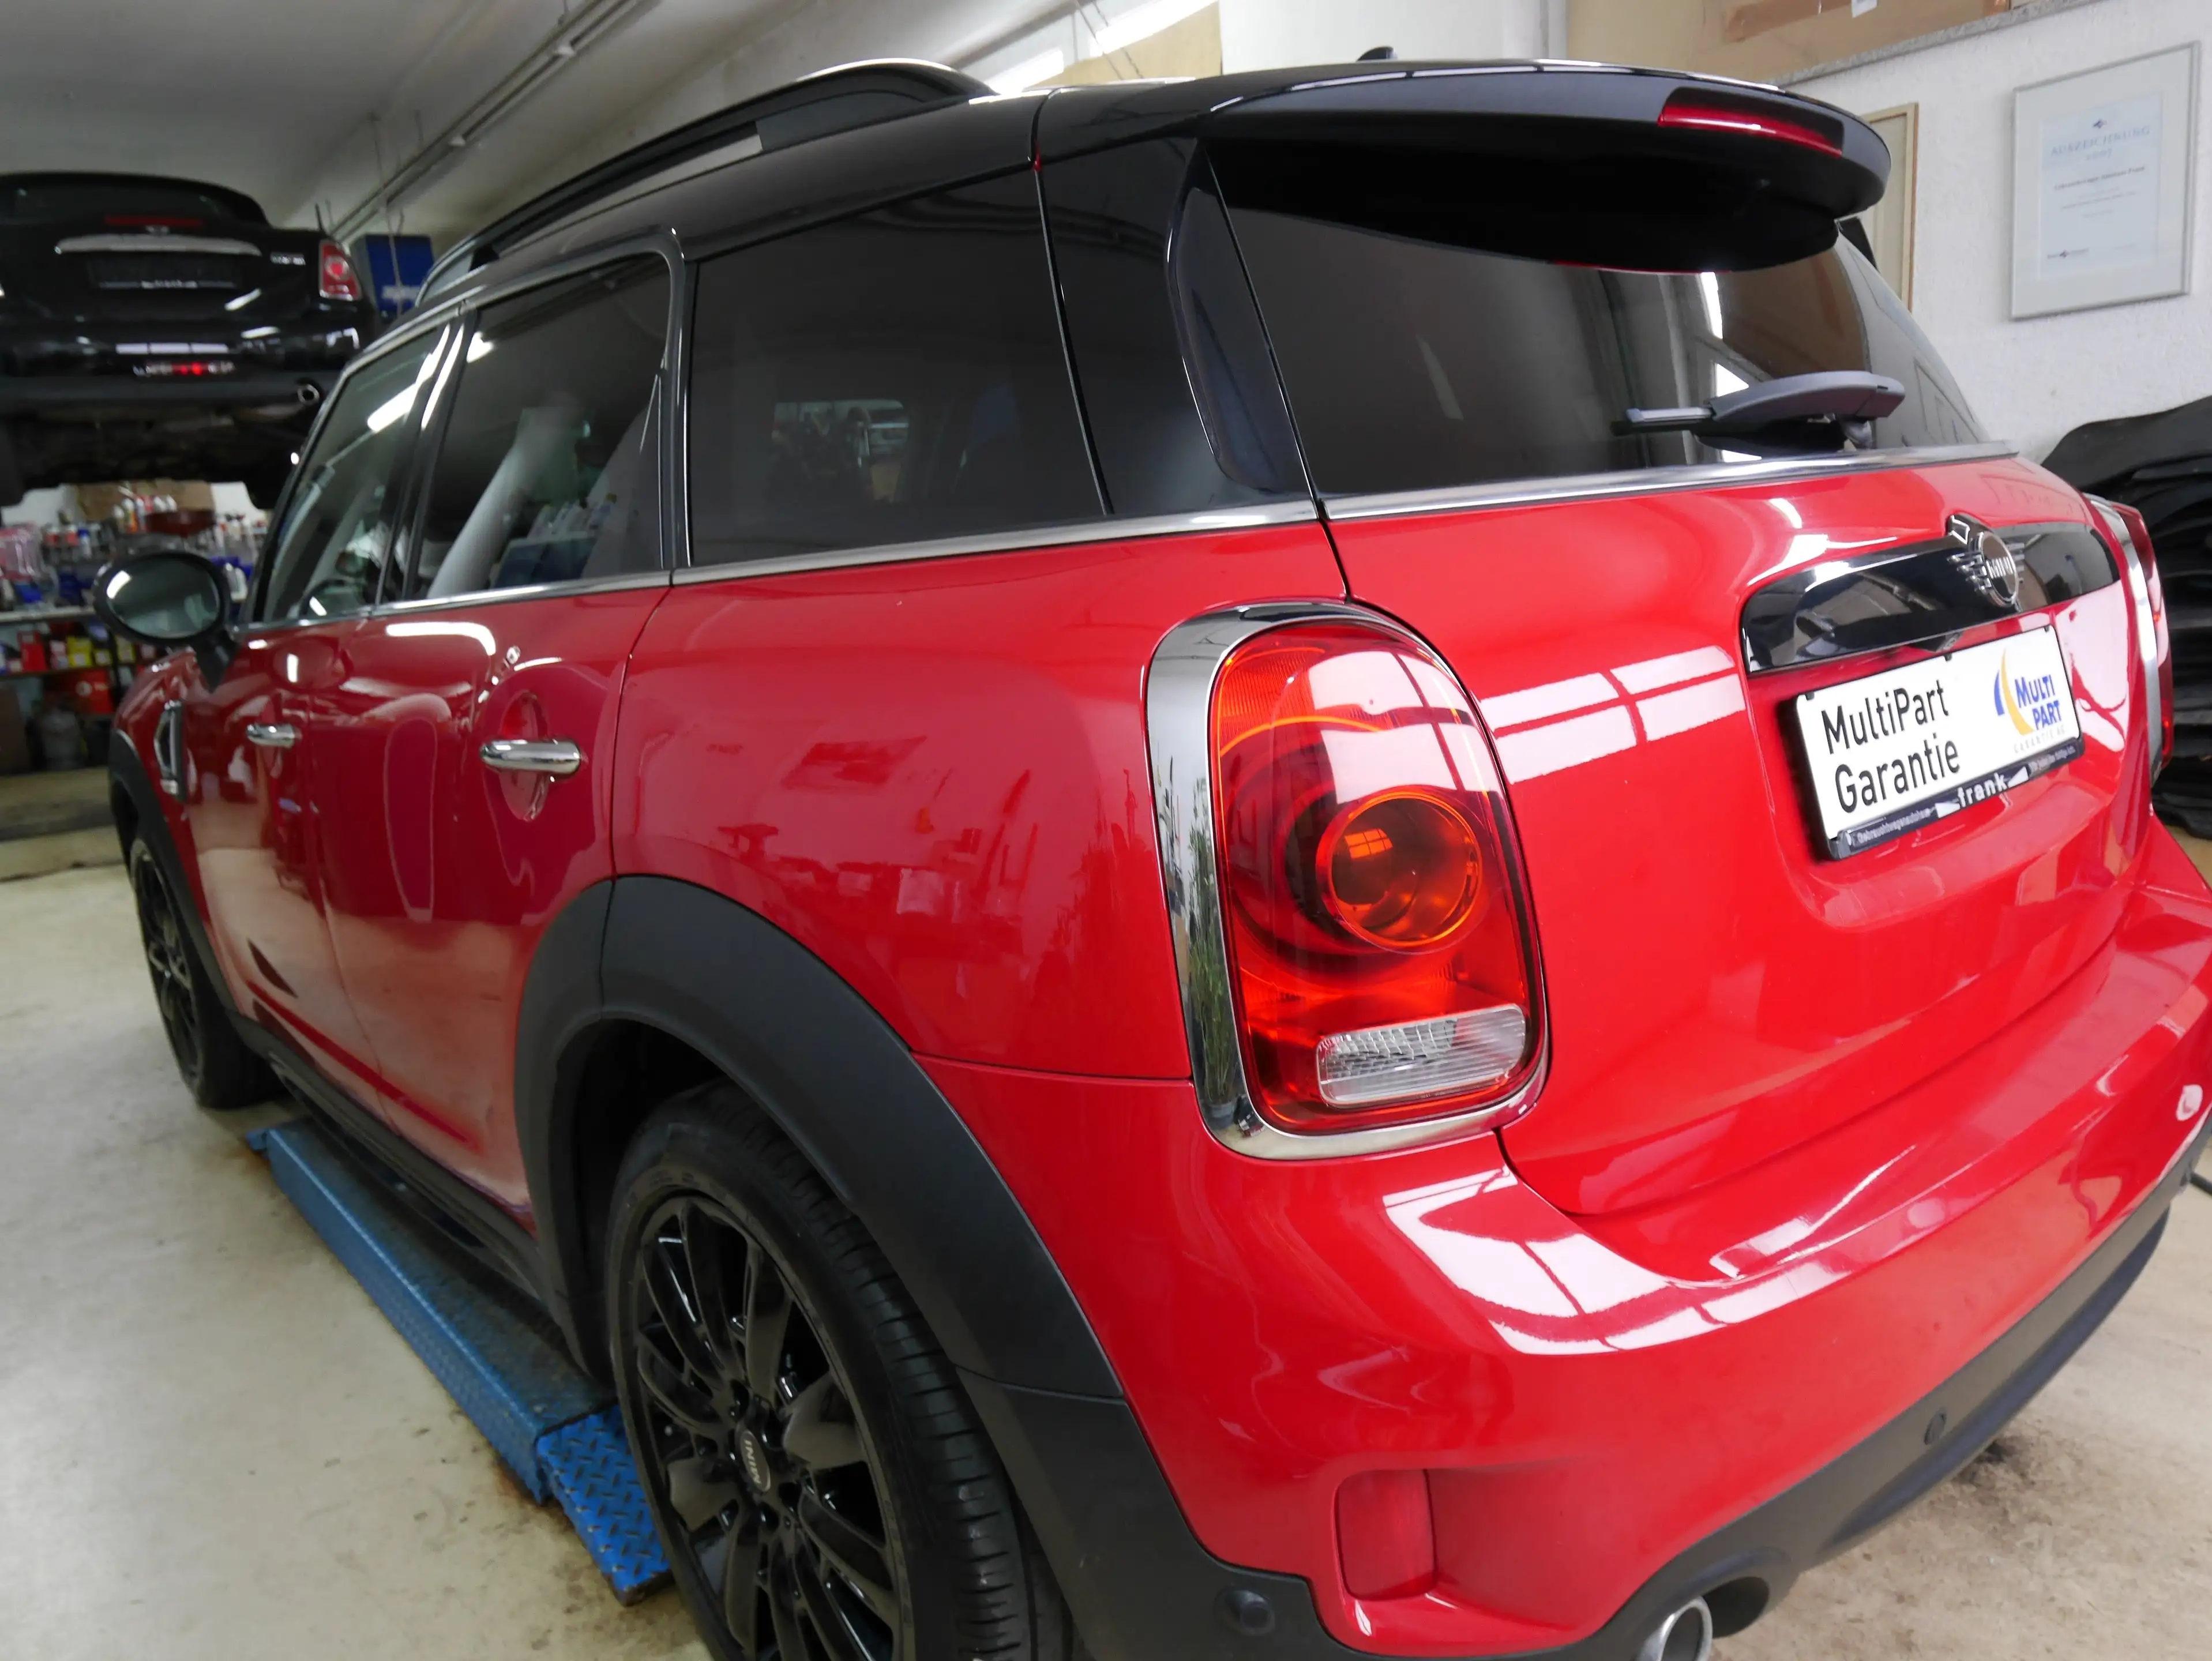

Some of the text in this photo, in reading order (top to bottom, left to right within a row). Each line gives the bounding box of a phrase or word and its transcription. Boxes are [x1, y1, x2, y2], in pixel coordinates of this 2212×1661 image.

[1986, 556, 2014, 579] MINI
[1820, 679, 1949, 754] MultiPart
[2033, 700, 2062, 731] PART
[1834, 733, 1960, 812] Garantie
[1957, 772, 2007, 807] frank
[743, 1440, 761, 1485] MINI
